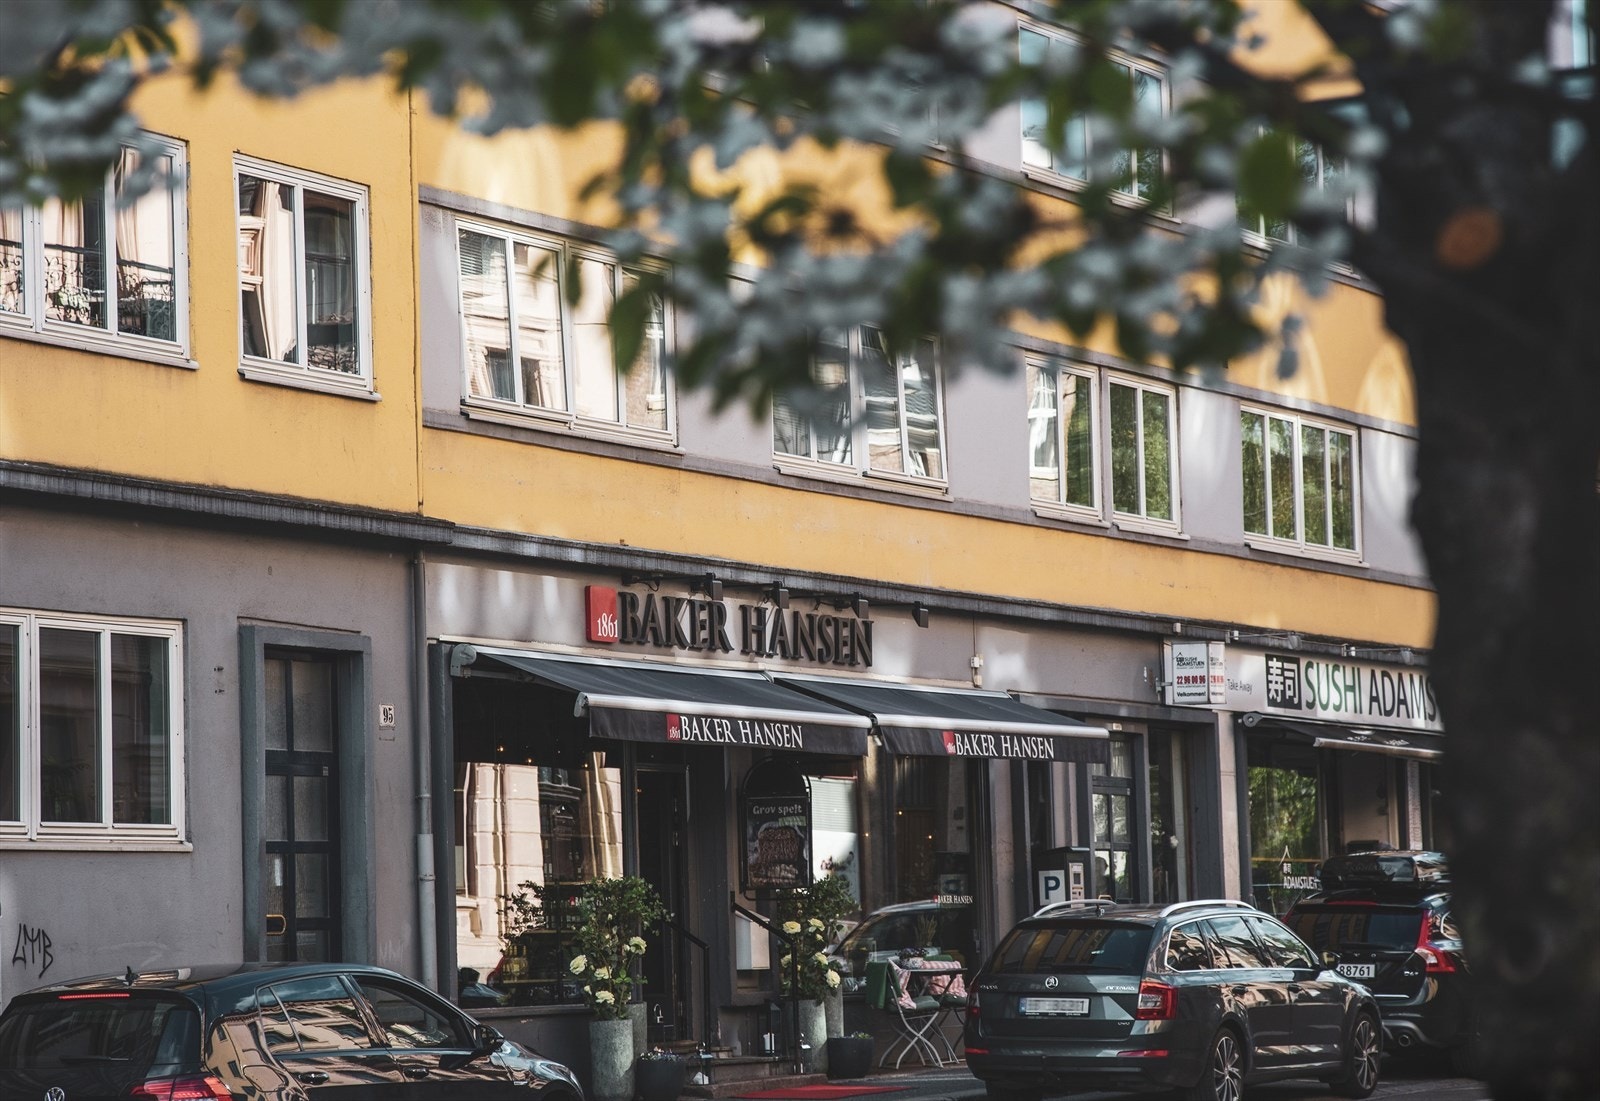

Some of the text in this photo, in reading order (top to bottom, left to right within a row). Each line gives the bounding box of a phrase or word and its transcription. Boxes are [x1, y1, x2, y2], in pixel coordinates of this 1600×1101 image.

[597, 591, 874, 667] 1861 BAKER HANSEN
[1176, 675, 1184, 685] 22
[1267, 657, 1299, 705] 寿司
[1304, 660, 1363, 715] SUSHI
[383, 707, 393, 723] 95
[680, 715, 737, 744] BAKER
[738, 720, 803, 749] HANSEN
[954, 733, 998, 757] BAKER
[1000, 735, 1055, 759] HANSEN
[753, 804, 802, 815] Grov spelt
[1044, 876, 1060, 900] P
